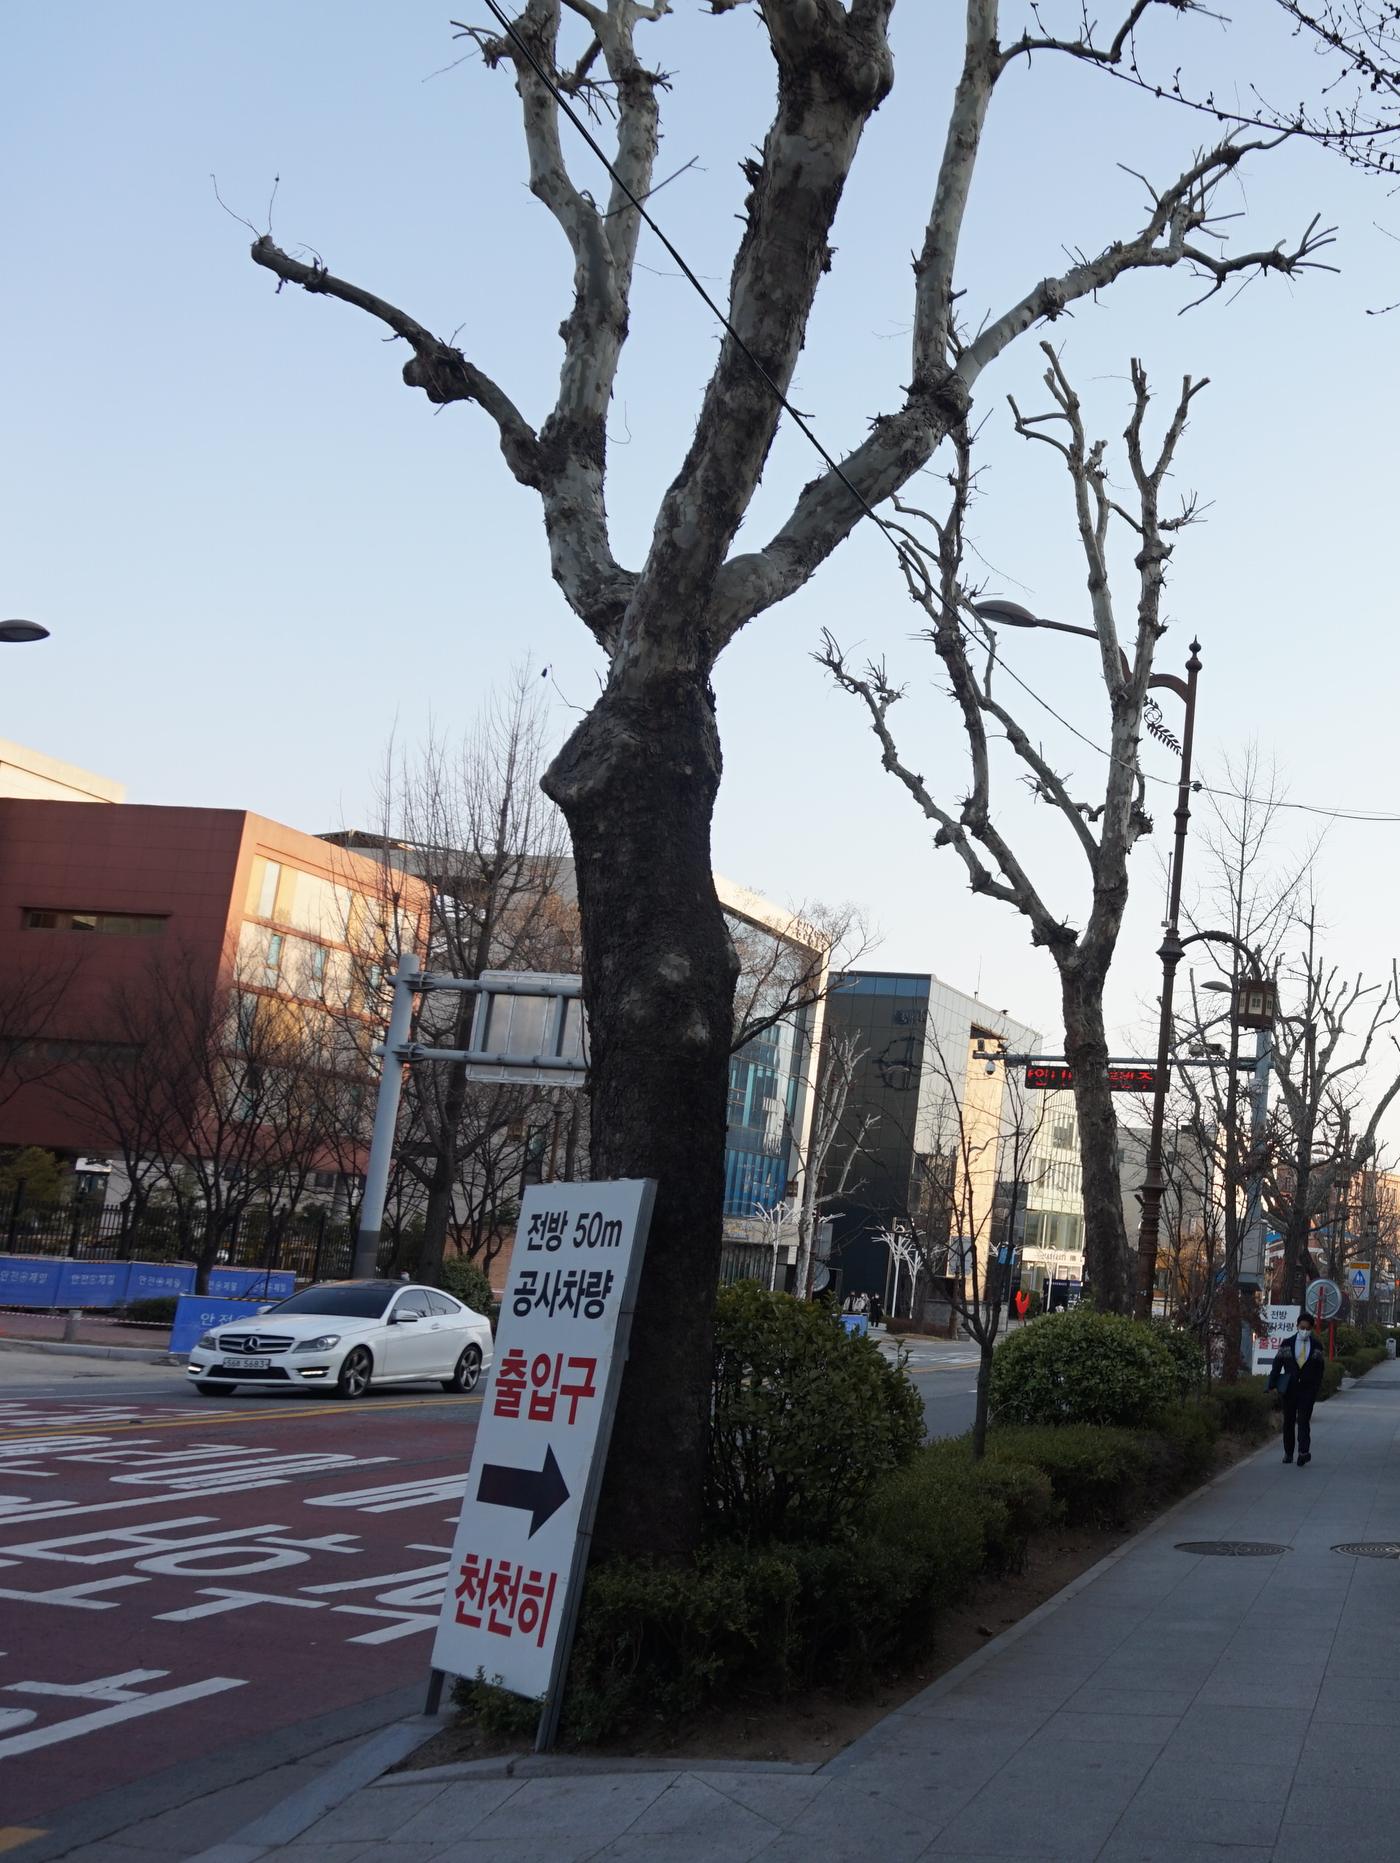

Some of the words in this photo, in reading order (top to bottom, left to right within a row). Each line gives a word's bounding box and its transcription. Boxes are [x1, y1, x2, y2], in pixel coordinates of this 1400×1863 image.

[527, 1209, 568, 1252] 전방
[573, 1210, 623, 1250] 50m
[512, 1268, 615, 1321] 공사차량
[1270, 1310, 1288, 1320] 전방
[493, 1348, 598, 1425] 출입구
[454, 1552, 558, 1648] 천천히
